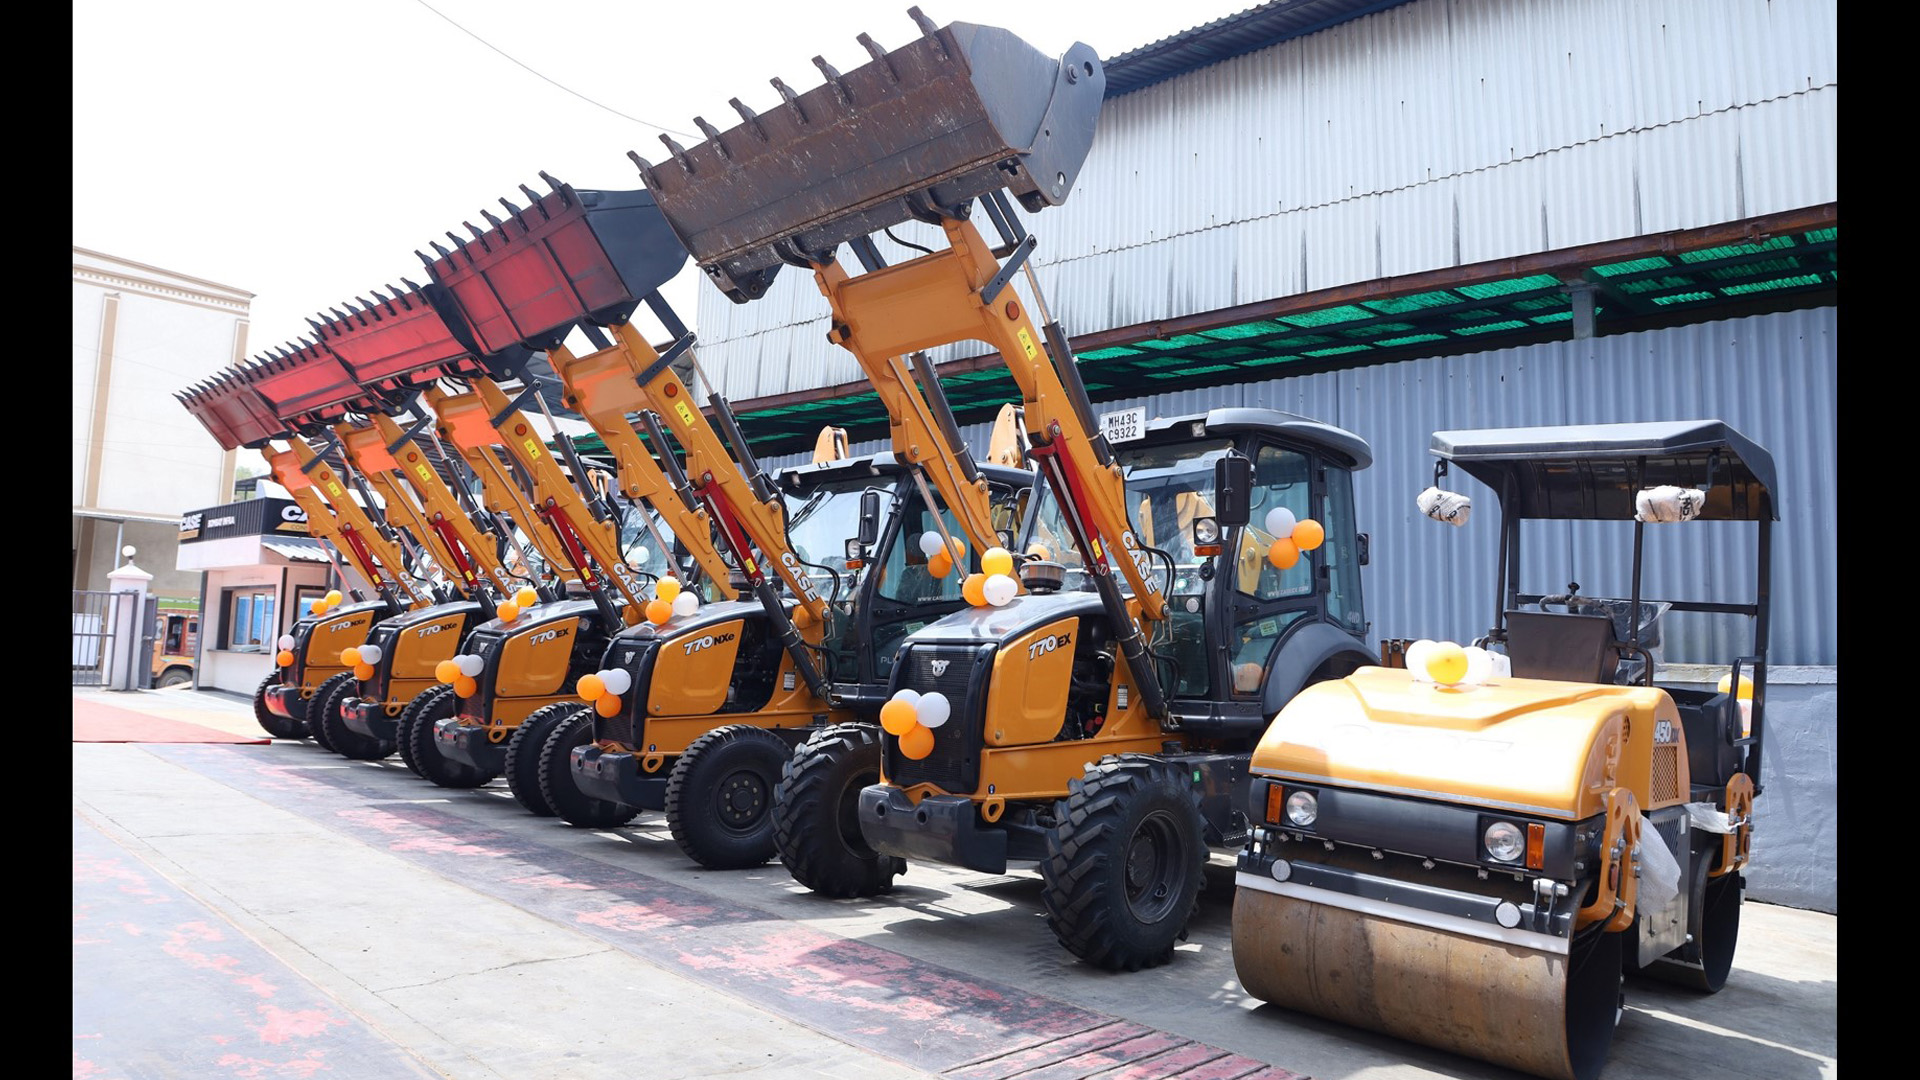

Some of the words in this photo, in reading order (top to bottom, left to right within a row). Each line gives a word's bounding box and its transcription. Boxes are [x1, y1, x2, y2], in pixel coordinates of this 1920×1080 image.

[1108, 412, 1137, 428] MH43C
[1108, 425, 1137, 441] C9322
[780, 550, 821, 604] CASE
[1122, 530, 1158, 596] CASE
[399, 571, 426, 601] CASE
[493, 566, 517, 595] CAS
[613, 562, 646, 605] CASE
